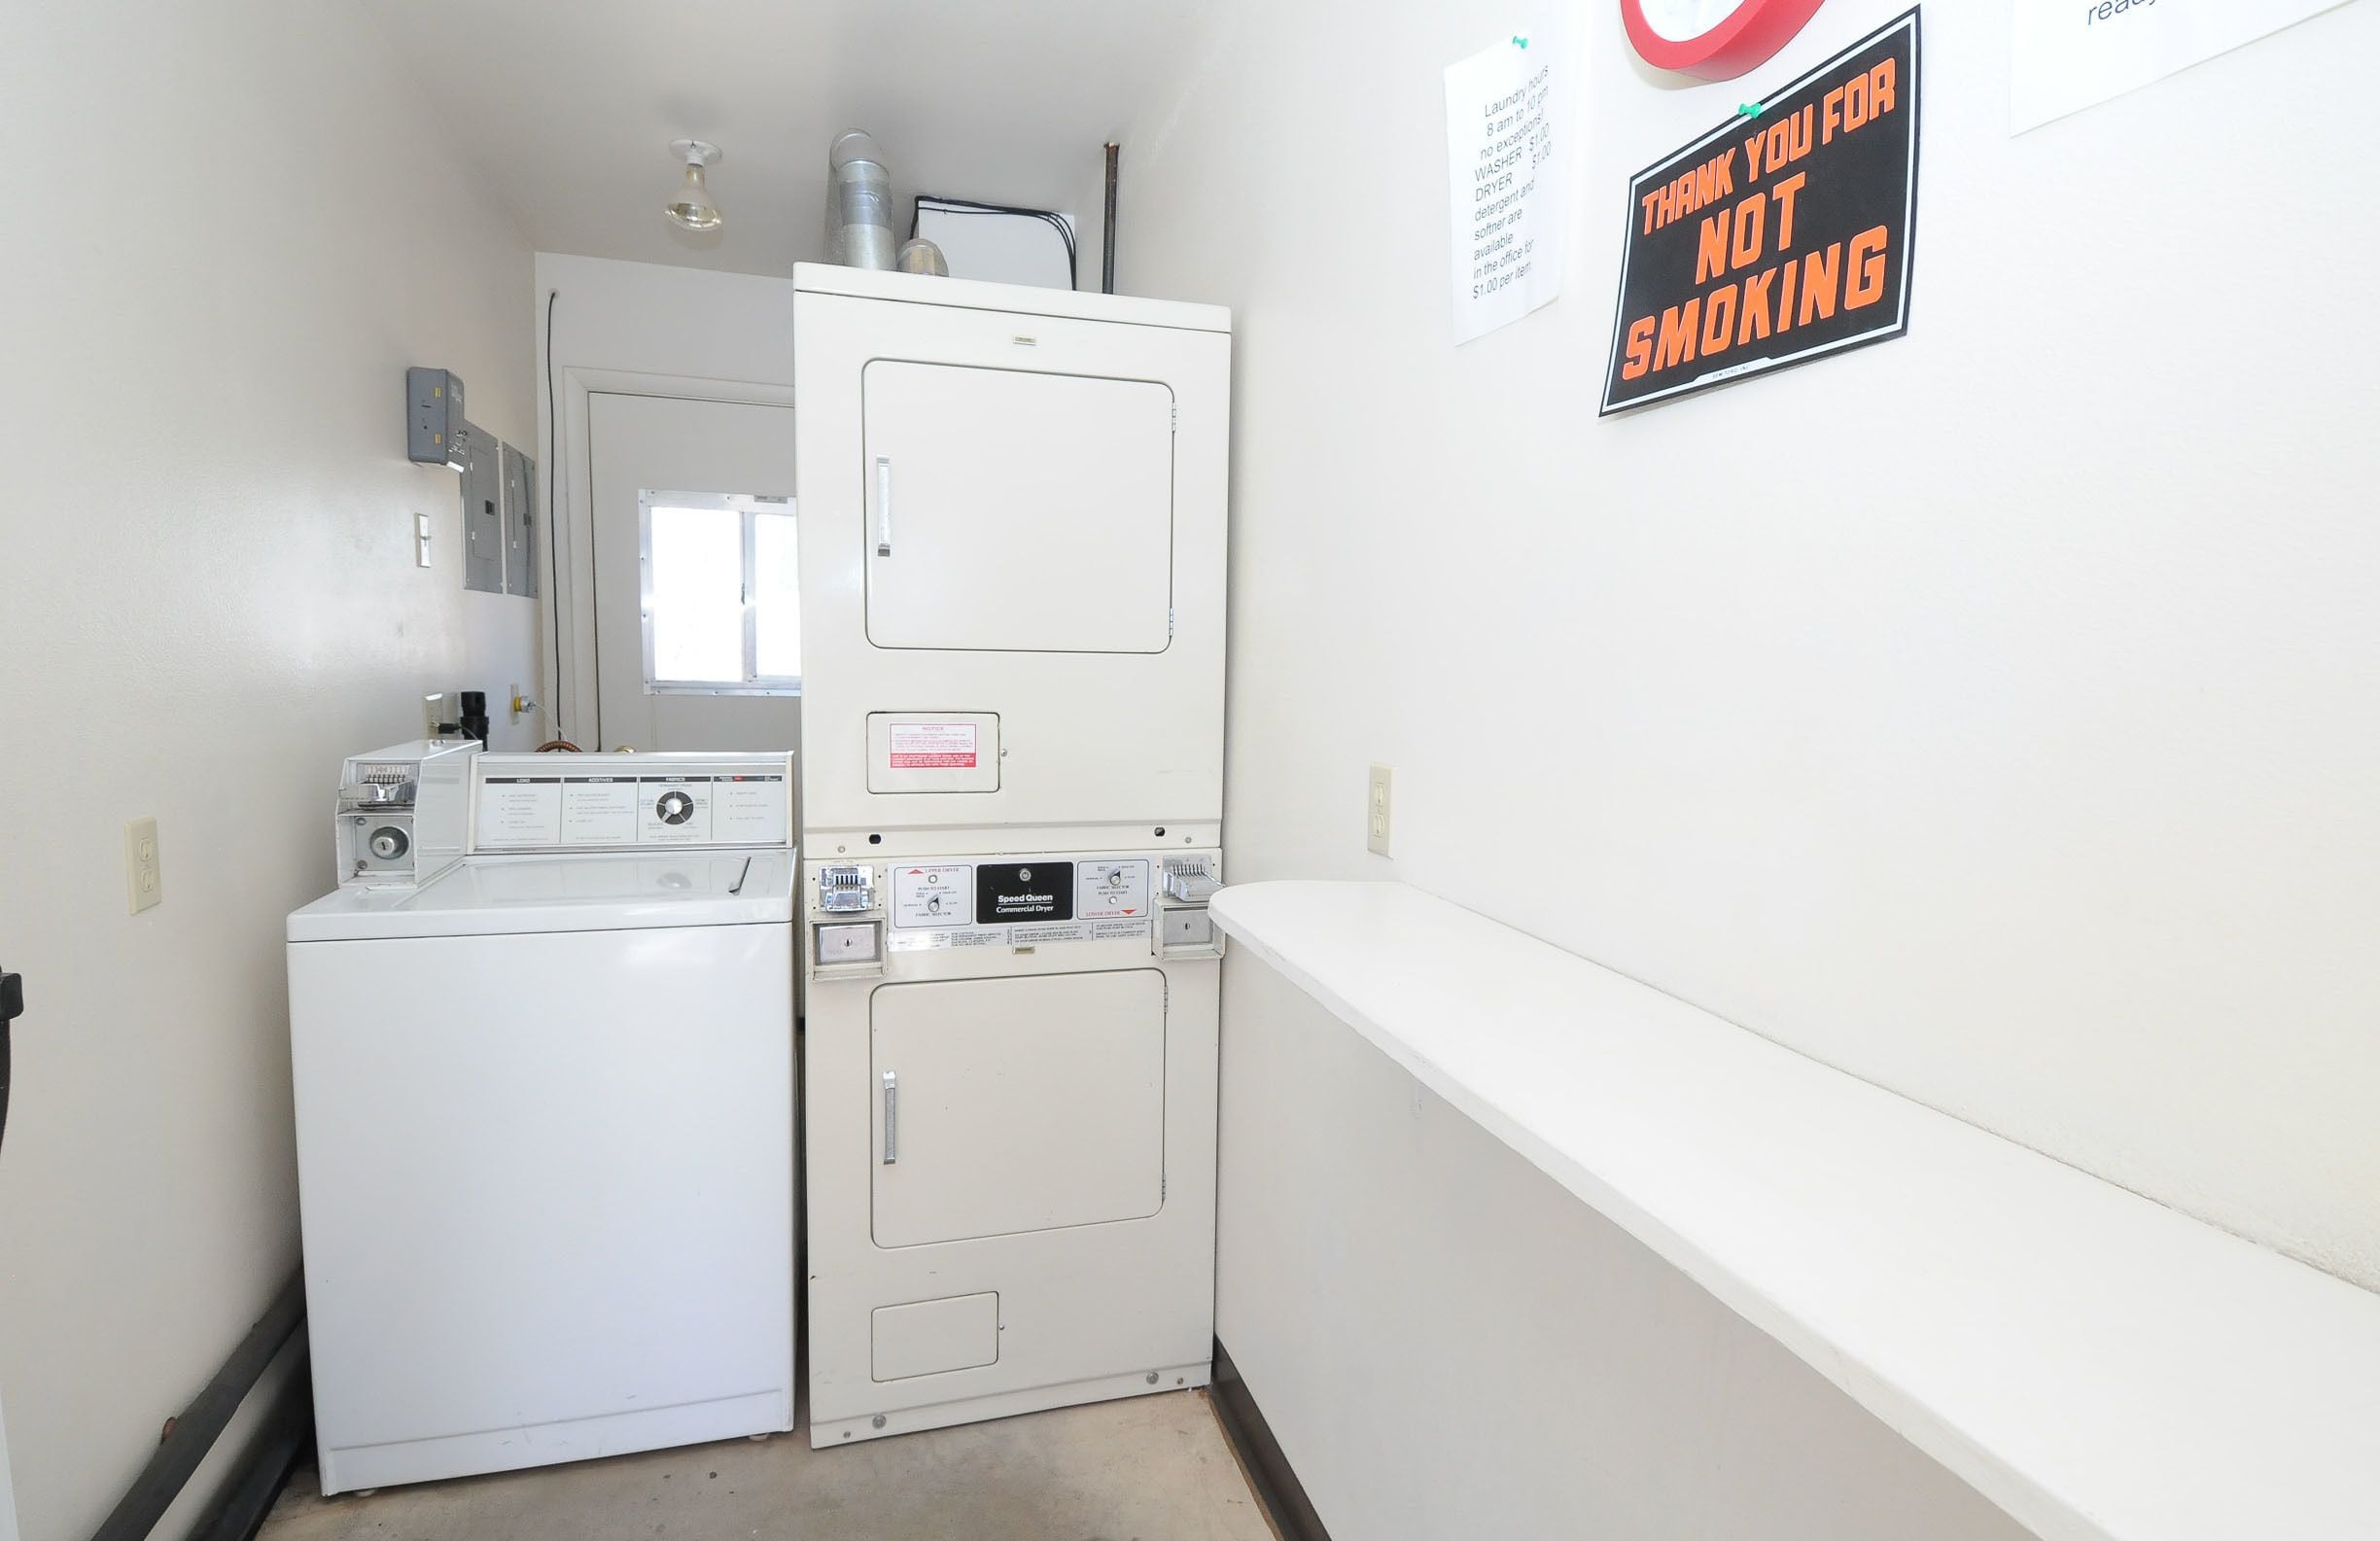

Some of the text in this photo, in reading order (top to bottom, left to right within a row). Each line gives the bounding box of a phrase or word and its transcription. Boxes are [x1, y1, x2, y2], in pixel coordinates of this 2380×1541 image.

[2088, 0, 2155, 25] rea
[1485, 65, 1548, 118] Laundry hours
[1488, 123, 1493, 137] 8
[1497, 116, 1513, 132] am
[1516, 108, 1523, 122] to
[1527, 95, 1536, 113] 10
[1475, 123, 1549, 182] WASHER $1.00
[1481, 146, 1493, 160] no
[1642, 56, 1896, 236] THANK YOU FOR
[1475, 141, 1551, 202] DRYER $1.00
[1475, 177, 1535, 222] detergent and
[1474, 208, 1522, 240] softner are
[1695, 171, 1806, 286] NOT
[1474, 233, 1514, 261] available
[1474, 238, 1534, 279] in the office for
[1473, 277, 1497, 299] $1.00
[1500, 272, 1514, 290] per
[1622, 225, 1888, 381] SMOKING
[998, 894, 1025, 903] Speed
[1035, 904, 1054, 913] Dryer
